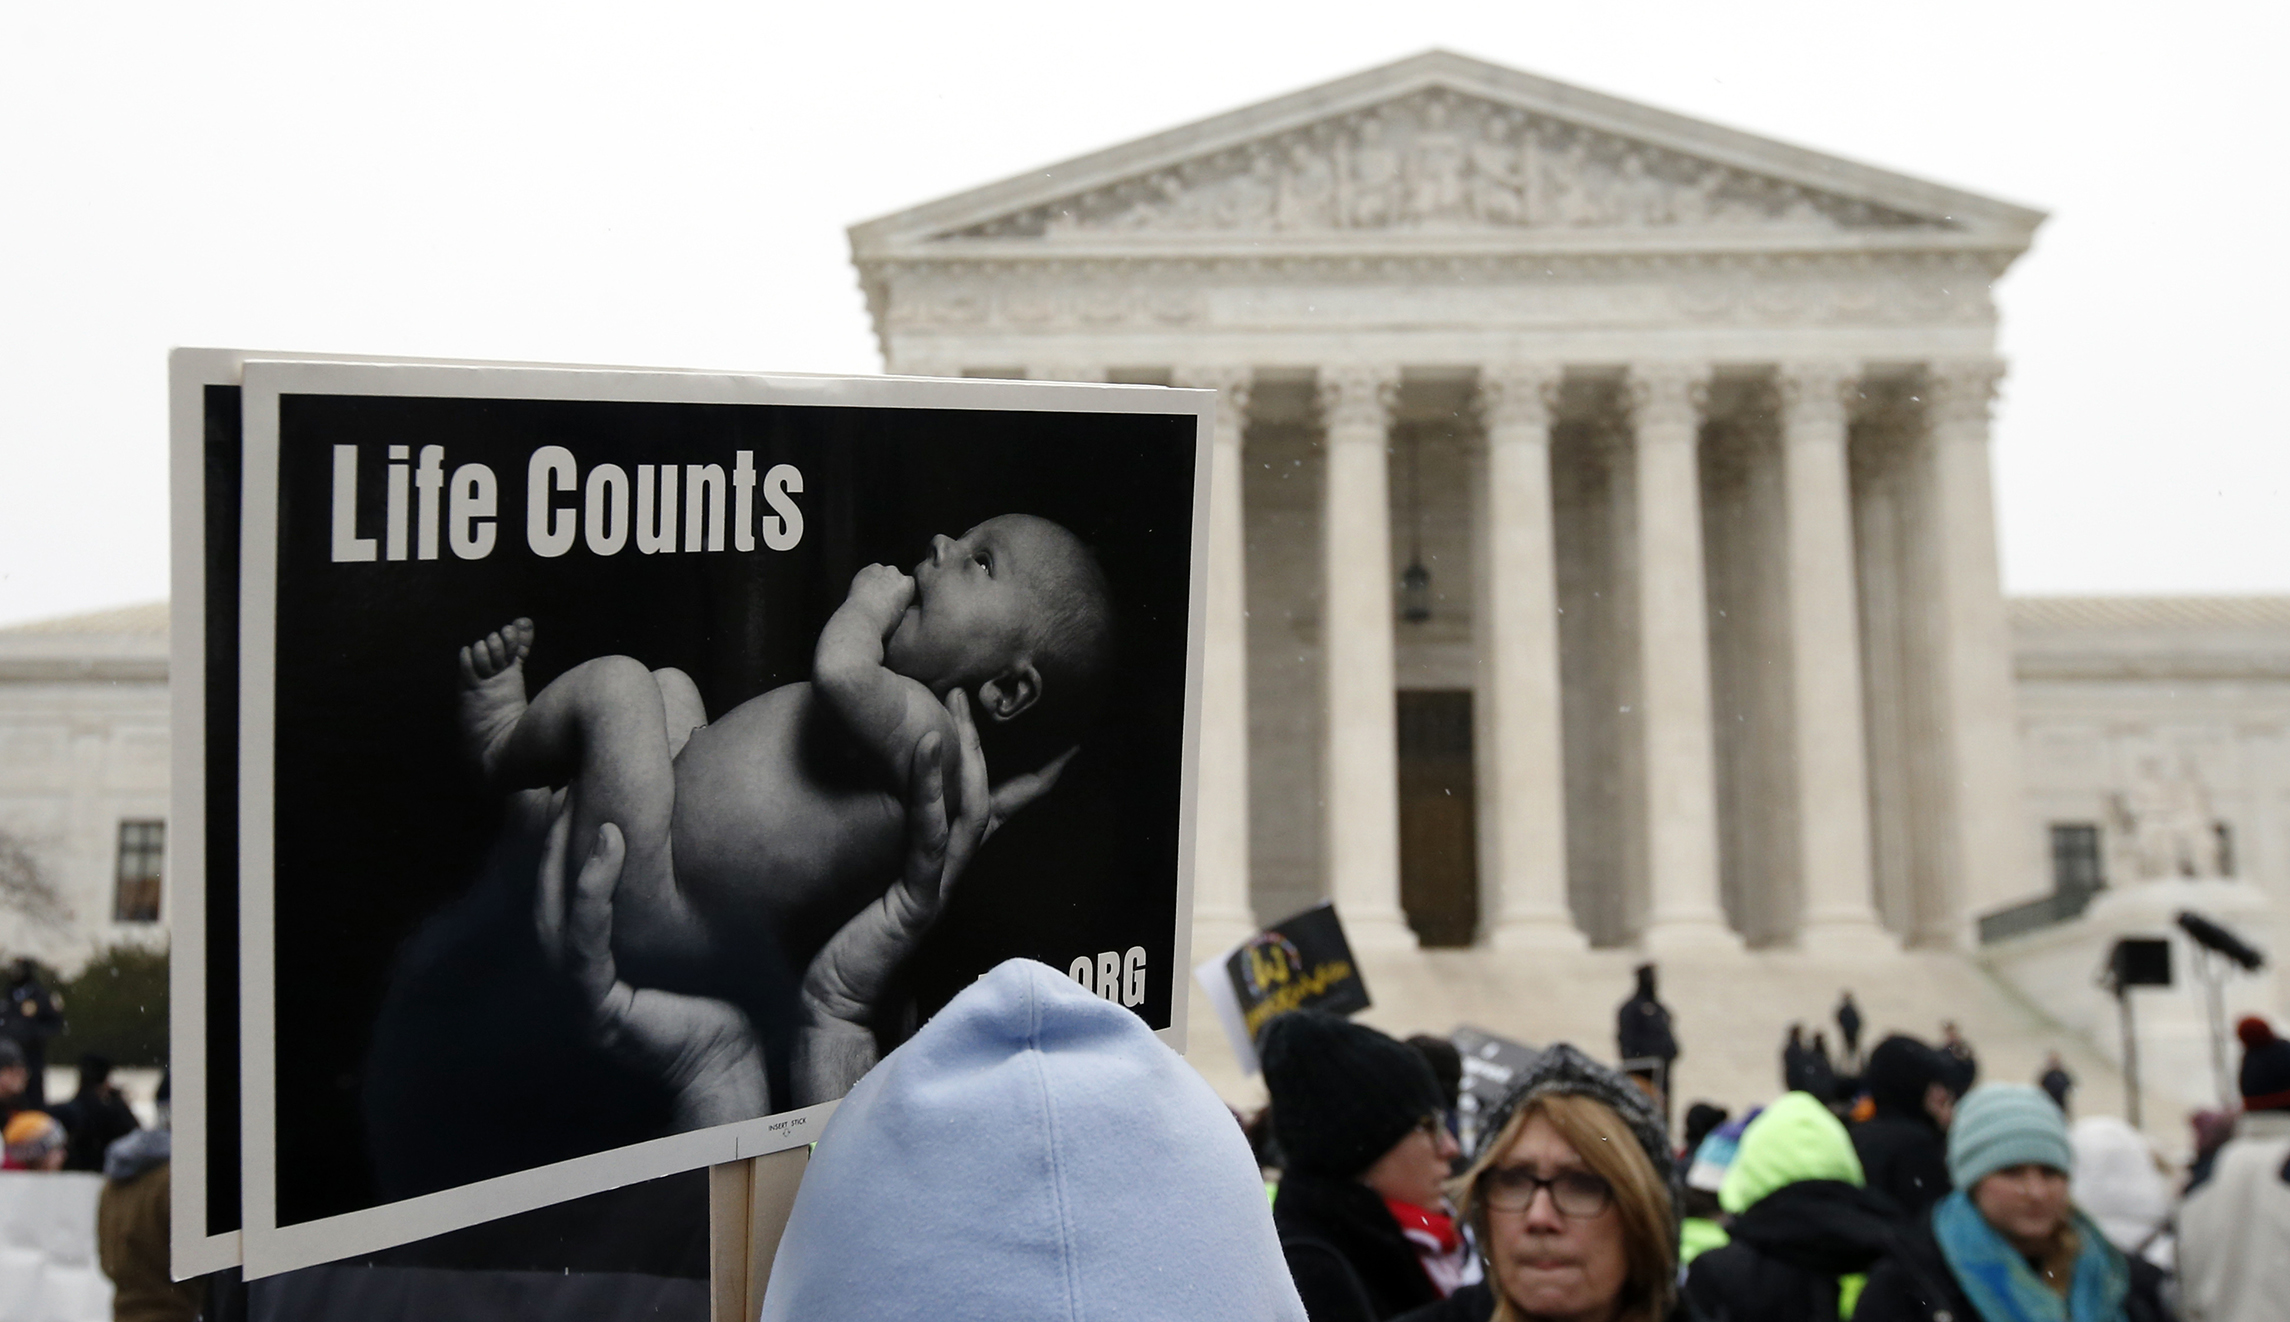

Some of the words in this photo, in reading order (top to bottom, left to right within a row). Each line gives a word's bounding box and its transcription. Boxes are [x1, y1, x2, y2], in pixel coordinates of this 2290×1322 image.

[331, 444, 498, 562] Life
[526, 445, 804, 557] Counts
[768, 1121, 788, 1132] INSERT
[791, 1117, 807, 1127] STICK
